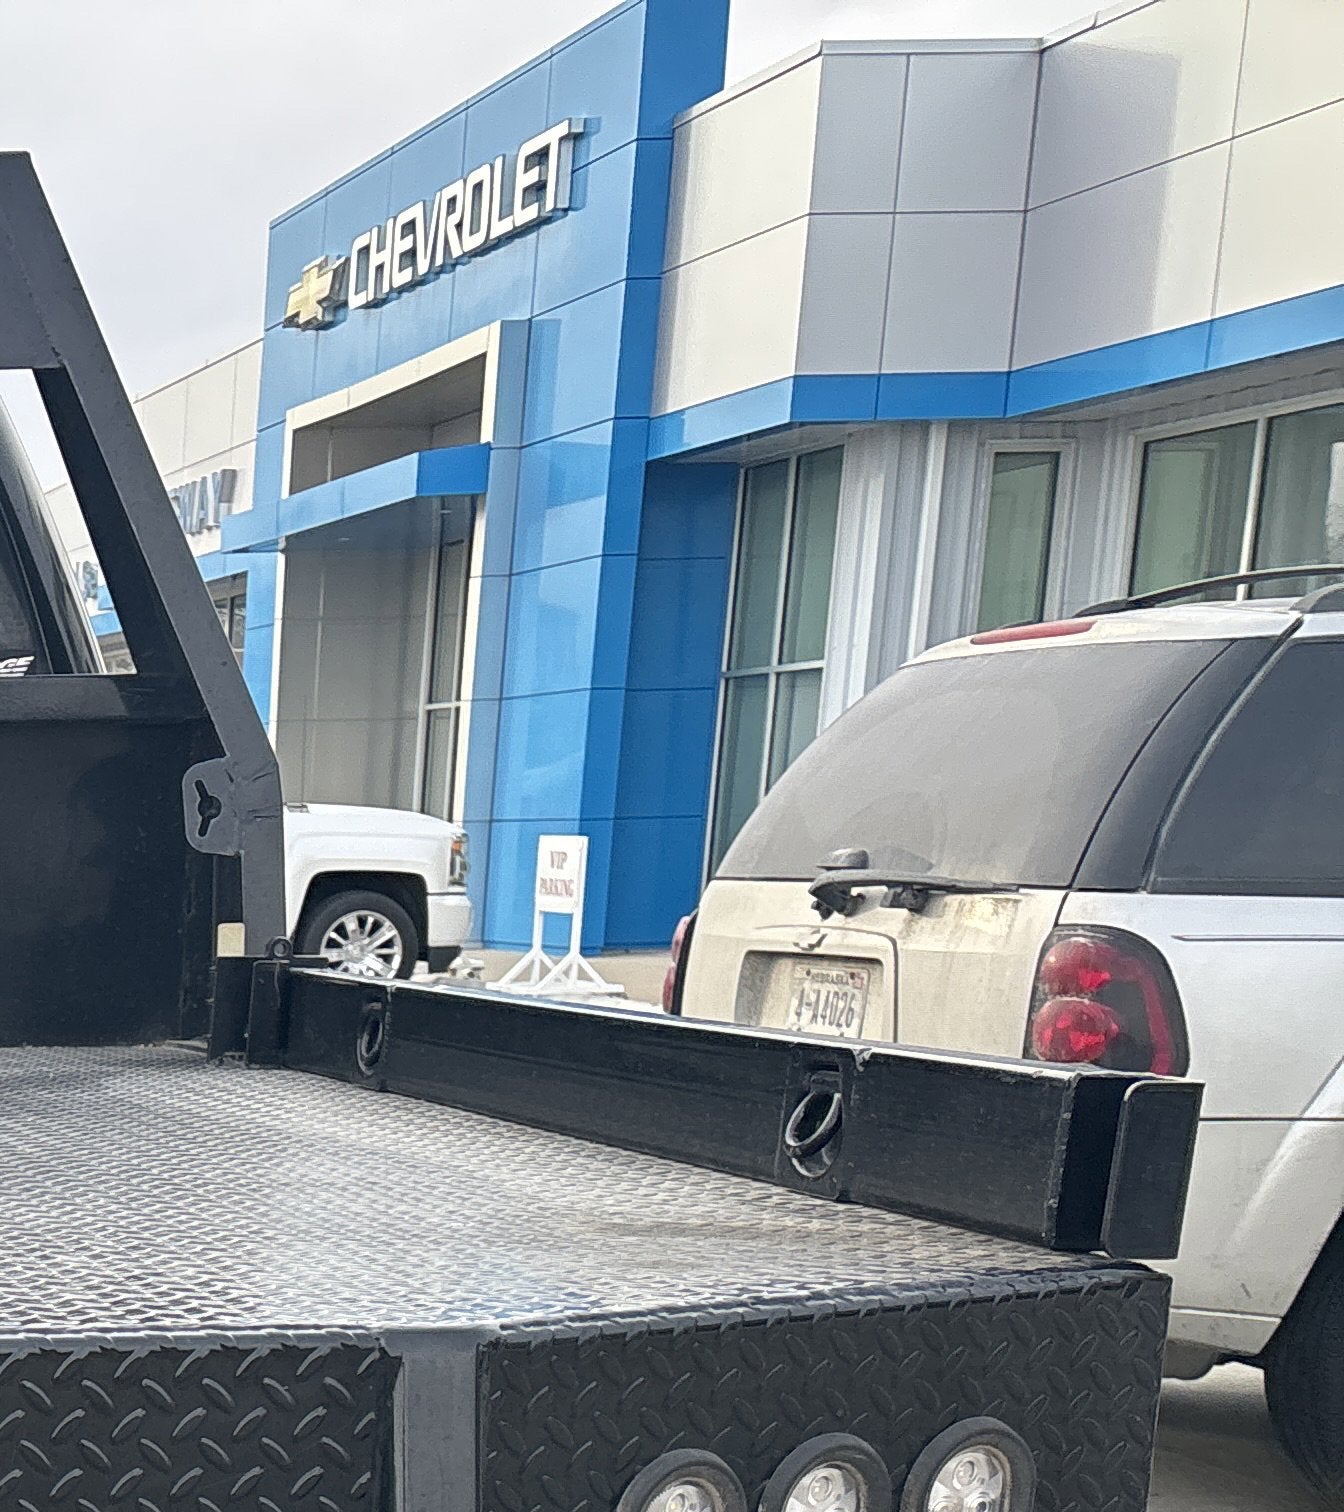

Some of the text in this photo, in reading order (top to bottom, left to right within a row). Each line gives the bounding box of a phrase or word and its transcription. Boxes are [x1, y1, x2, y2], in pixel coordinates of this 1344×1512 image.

[346, 118, 586, 310] CHEVROLET
[549, 850, 568, 870] VIP
[538, 877, 575, 897] PARKING
[811, 973, 850, 985] NEBRASKA
